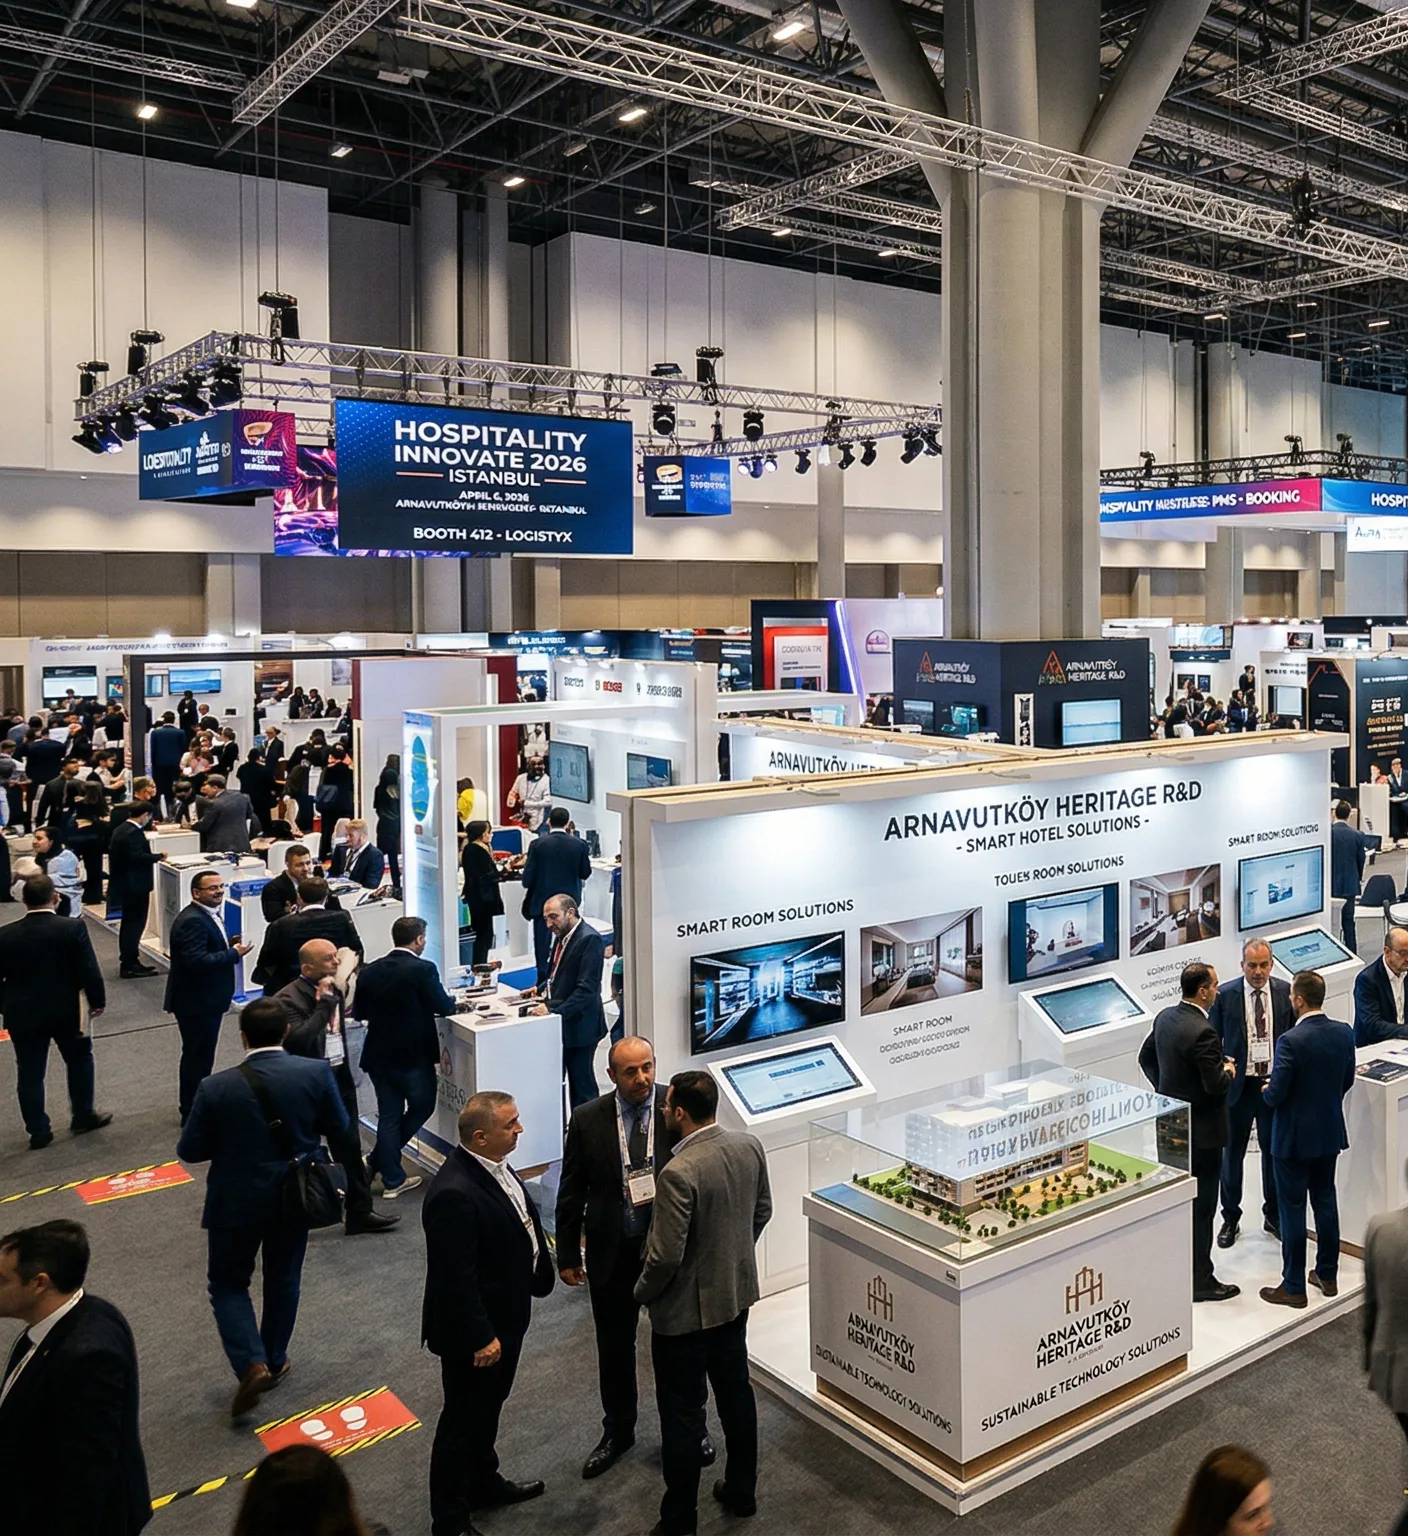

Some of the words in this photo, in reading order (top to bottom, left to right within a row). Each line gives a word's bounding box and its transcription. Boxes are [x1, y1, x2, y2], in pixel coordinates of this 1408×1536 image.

[394, 419, 587, 452] HOSPITALITY
[394, 444, 524, 469] INNOVATE
[530, 453, 587, 473] 2026
[449, 468, 541, 487] ISTANBUL
[1245, 489, 1301, 505] BOOKING
[413, 527, 467, 540] BOOTH
[469, 528, 494, 541] 412
[505, 529, 573, 543] LOGISTYX
[884, 794, 1049, 841] ARNAVUTKÖY
[1056, 785, 1157, 818] HERITAGE
[1162, 779, 1202, 805] R&D
[966, 832, 1016, 853] SMART
[1019, 825, 1064, 846] HOTEL
[1067, 815, 1141, 839] SOLUTIONS
[1067, 855, 1125, 875] SOLUTIONS
[677, 918, 728, 938] SMART
[732, 911, 774, 929] ROOM
[778, 899, 854, 922] SOLUTIONS
[1036, 1327, 1101, 1369] HERITAGE
[1104, 1316, 1132, 1339] R&D
[1037, 1299, 1131, 1353] ARNAVUTKÖY
[981, 1385, 1058, 1431] SUSTAINABLE
[1058, 1352, 1126, 1394] TECHNOLOGY
[1128, 1326, 1181, 1362] SOLUTIONS
